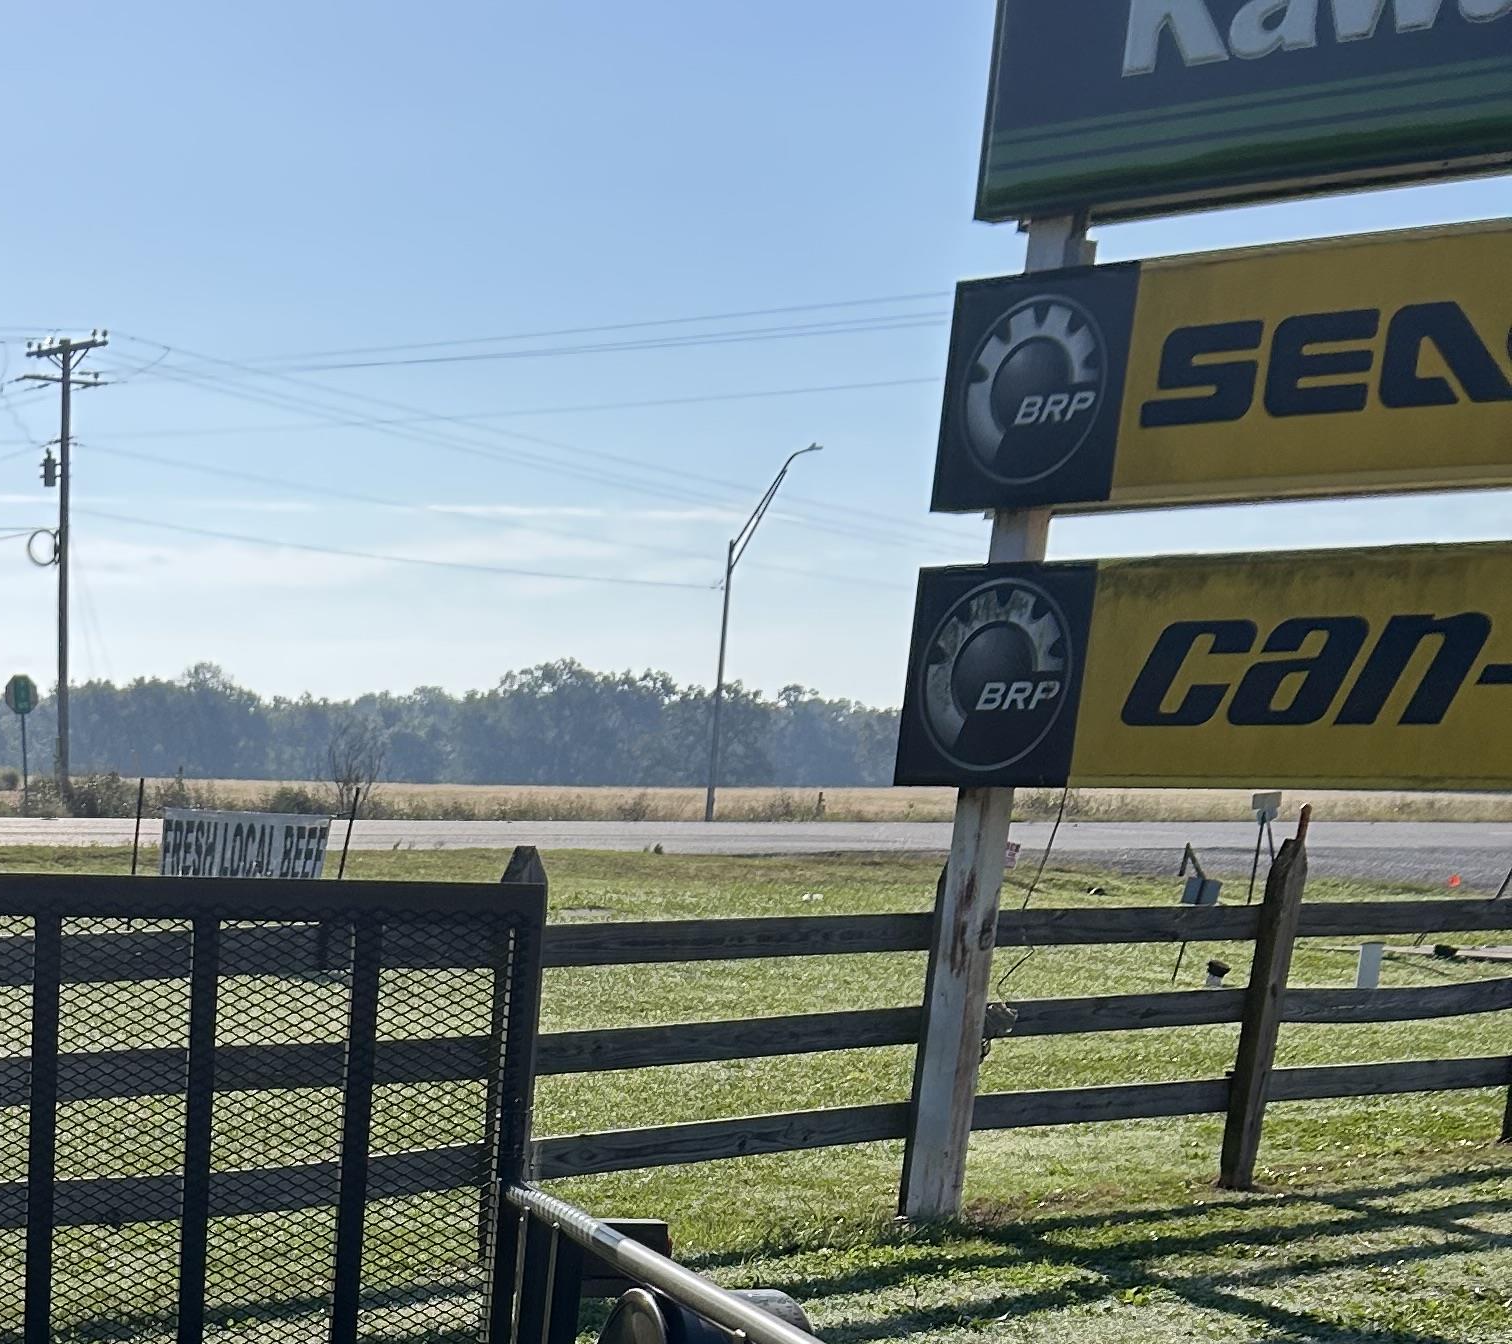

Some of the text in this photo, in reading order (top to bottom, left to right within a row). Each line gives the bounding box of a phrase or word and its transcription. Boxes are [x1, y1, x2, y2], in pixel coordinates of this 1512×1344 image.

[1122, 0, 1512, 78] Ka
[1014, 391, 1095, 427] BRP
[975, 679, 1061, 712] BRP
[161, 818, 329, 878] FRESH LOCAL BEEF
